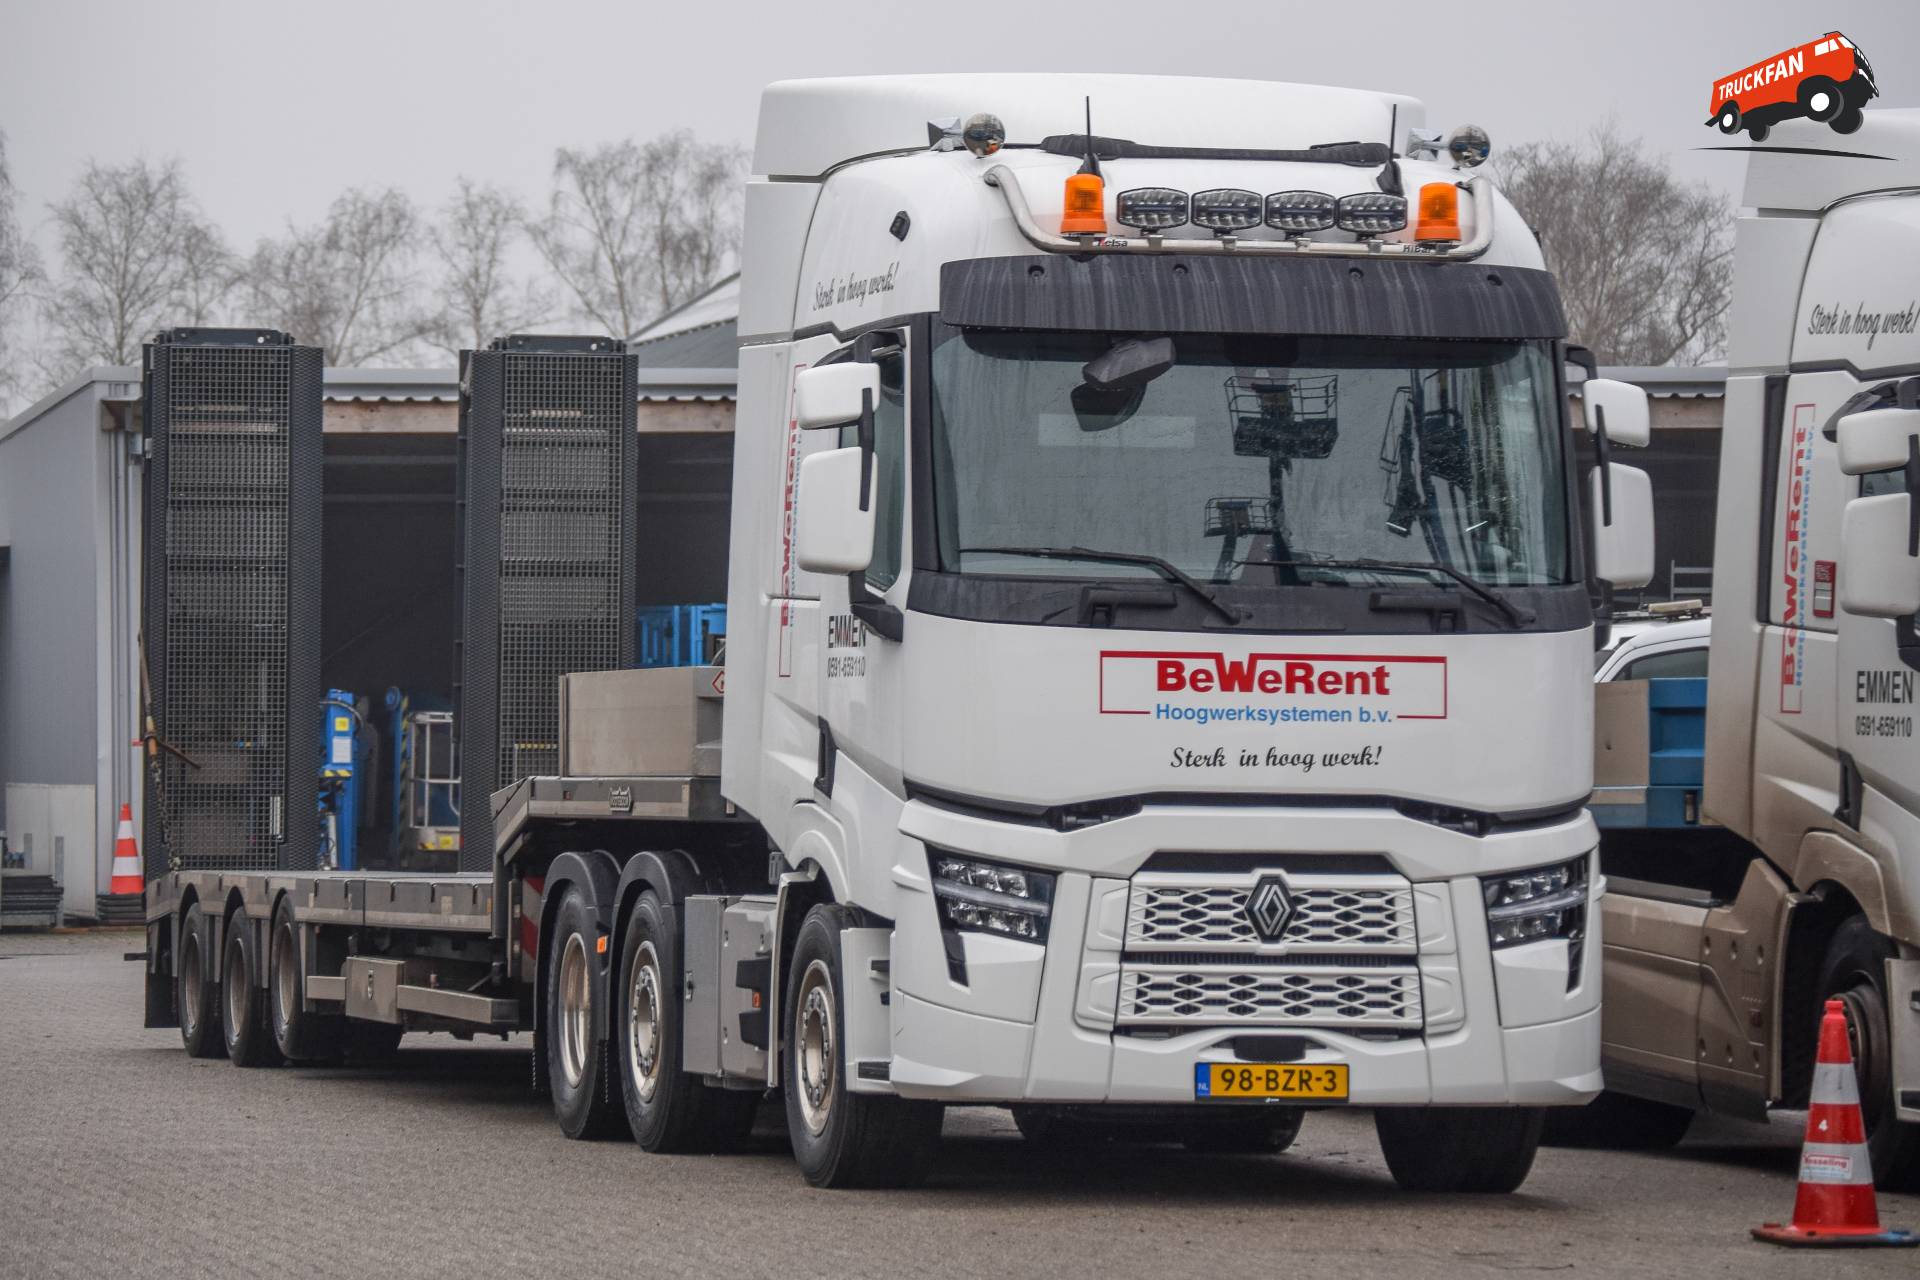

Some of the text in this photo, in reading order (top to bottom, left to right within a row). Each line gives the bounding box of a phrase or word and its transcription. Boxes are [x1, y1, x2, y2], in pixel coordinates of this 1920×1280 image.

[1808, 300, 1920, 351] Sterk in hoog werk!
[1783, 427, 1806, 685] BeWeRent
[828, 615, 866, 648] EMMEN
[1157, 653, 1390, 695] BeWeRent
[1856, 670, 1913, 703] EMMEN
[1156, 703, 1392, 725] Hoogwerksystemen b.v.
[1856, 715, 1912, 737] 0591-659110
[1170, 745, 1382, 773] Sterk in hoog werk!
[1198, 1082, 1208, 1091] NL
[1221, 1068, 1337, 1092] 98-BZR-3
